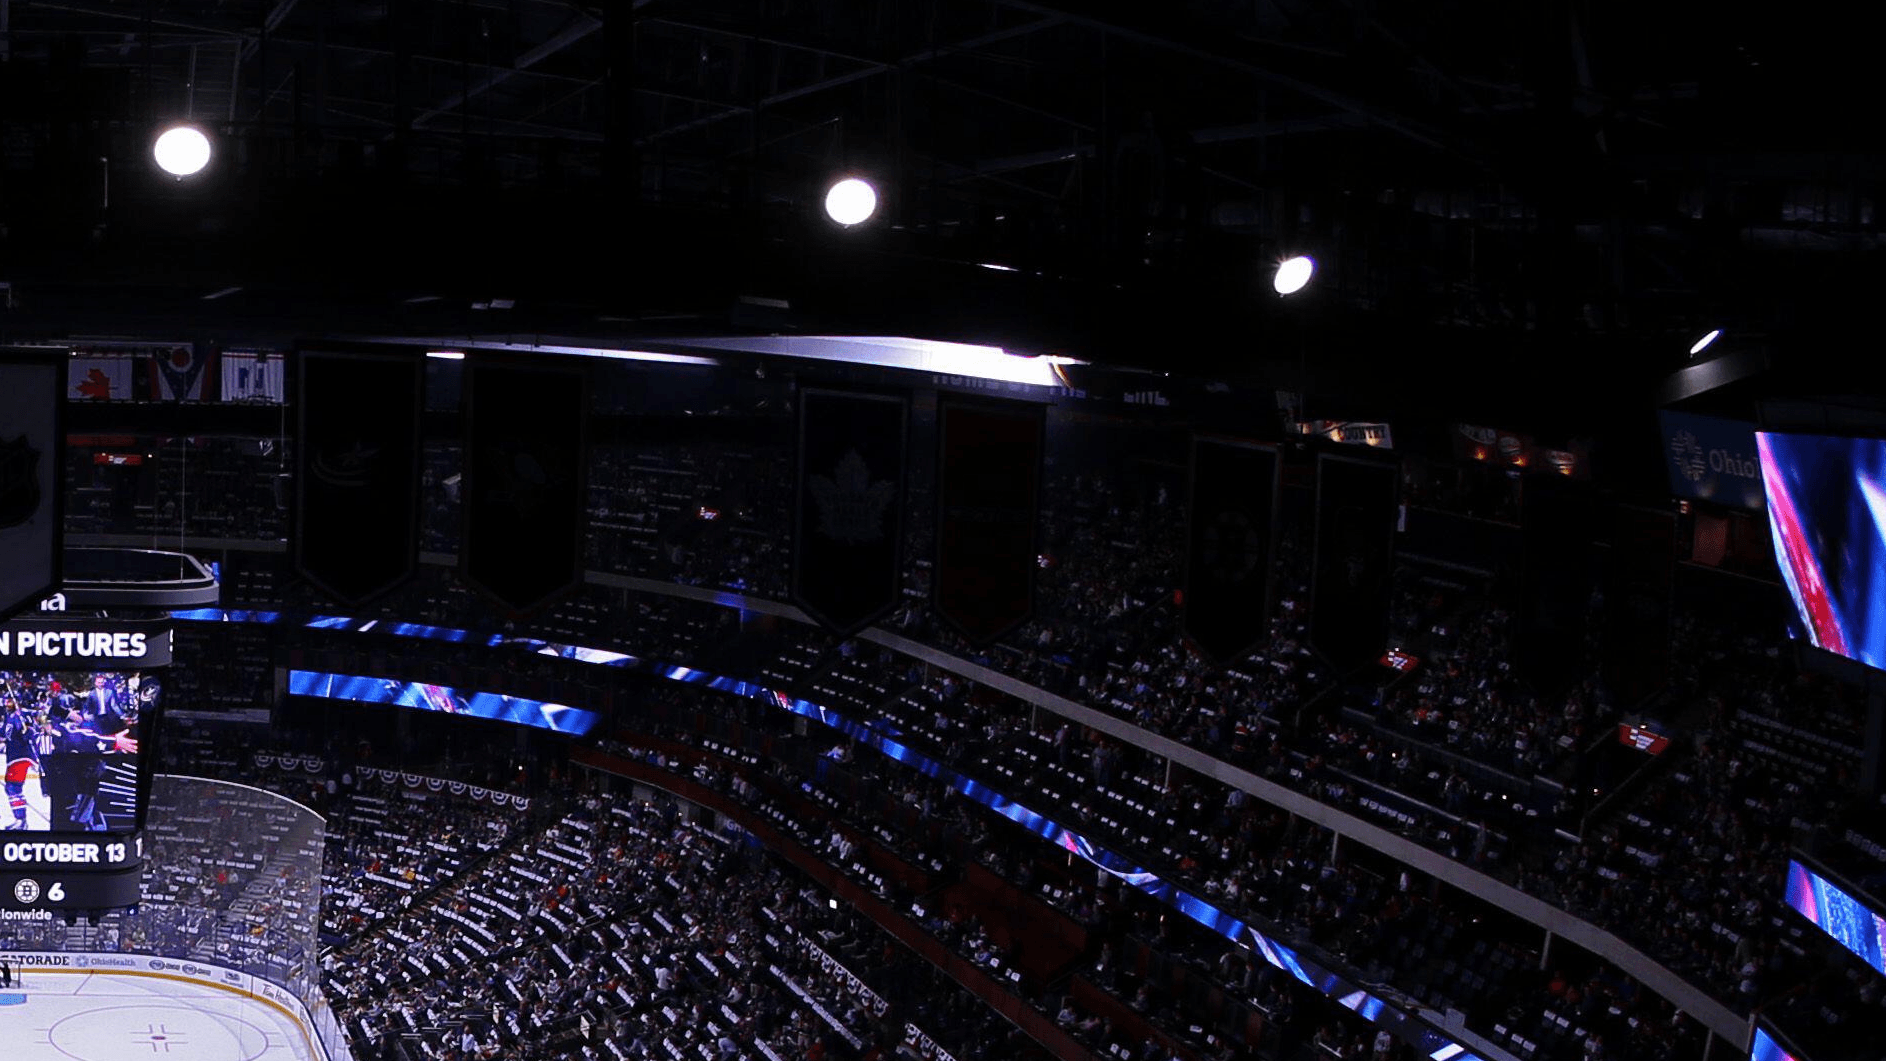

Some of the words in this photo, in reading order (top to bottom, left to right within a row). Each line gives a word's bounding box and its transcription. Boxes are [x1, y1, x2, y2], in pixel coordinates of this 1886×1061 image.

[17, 632, 147, 658] PICTURES
[3, 842, 100, 863] OCTOBER
[105, 843, 126, 863] 13
[47, 882, 66, 902] 6
